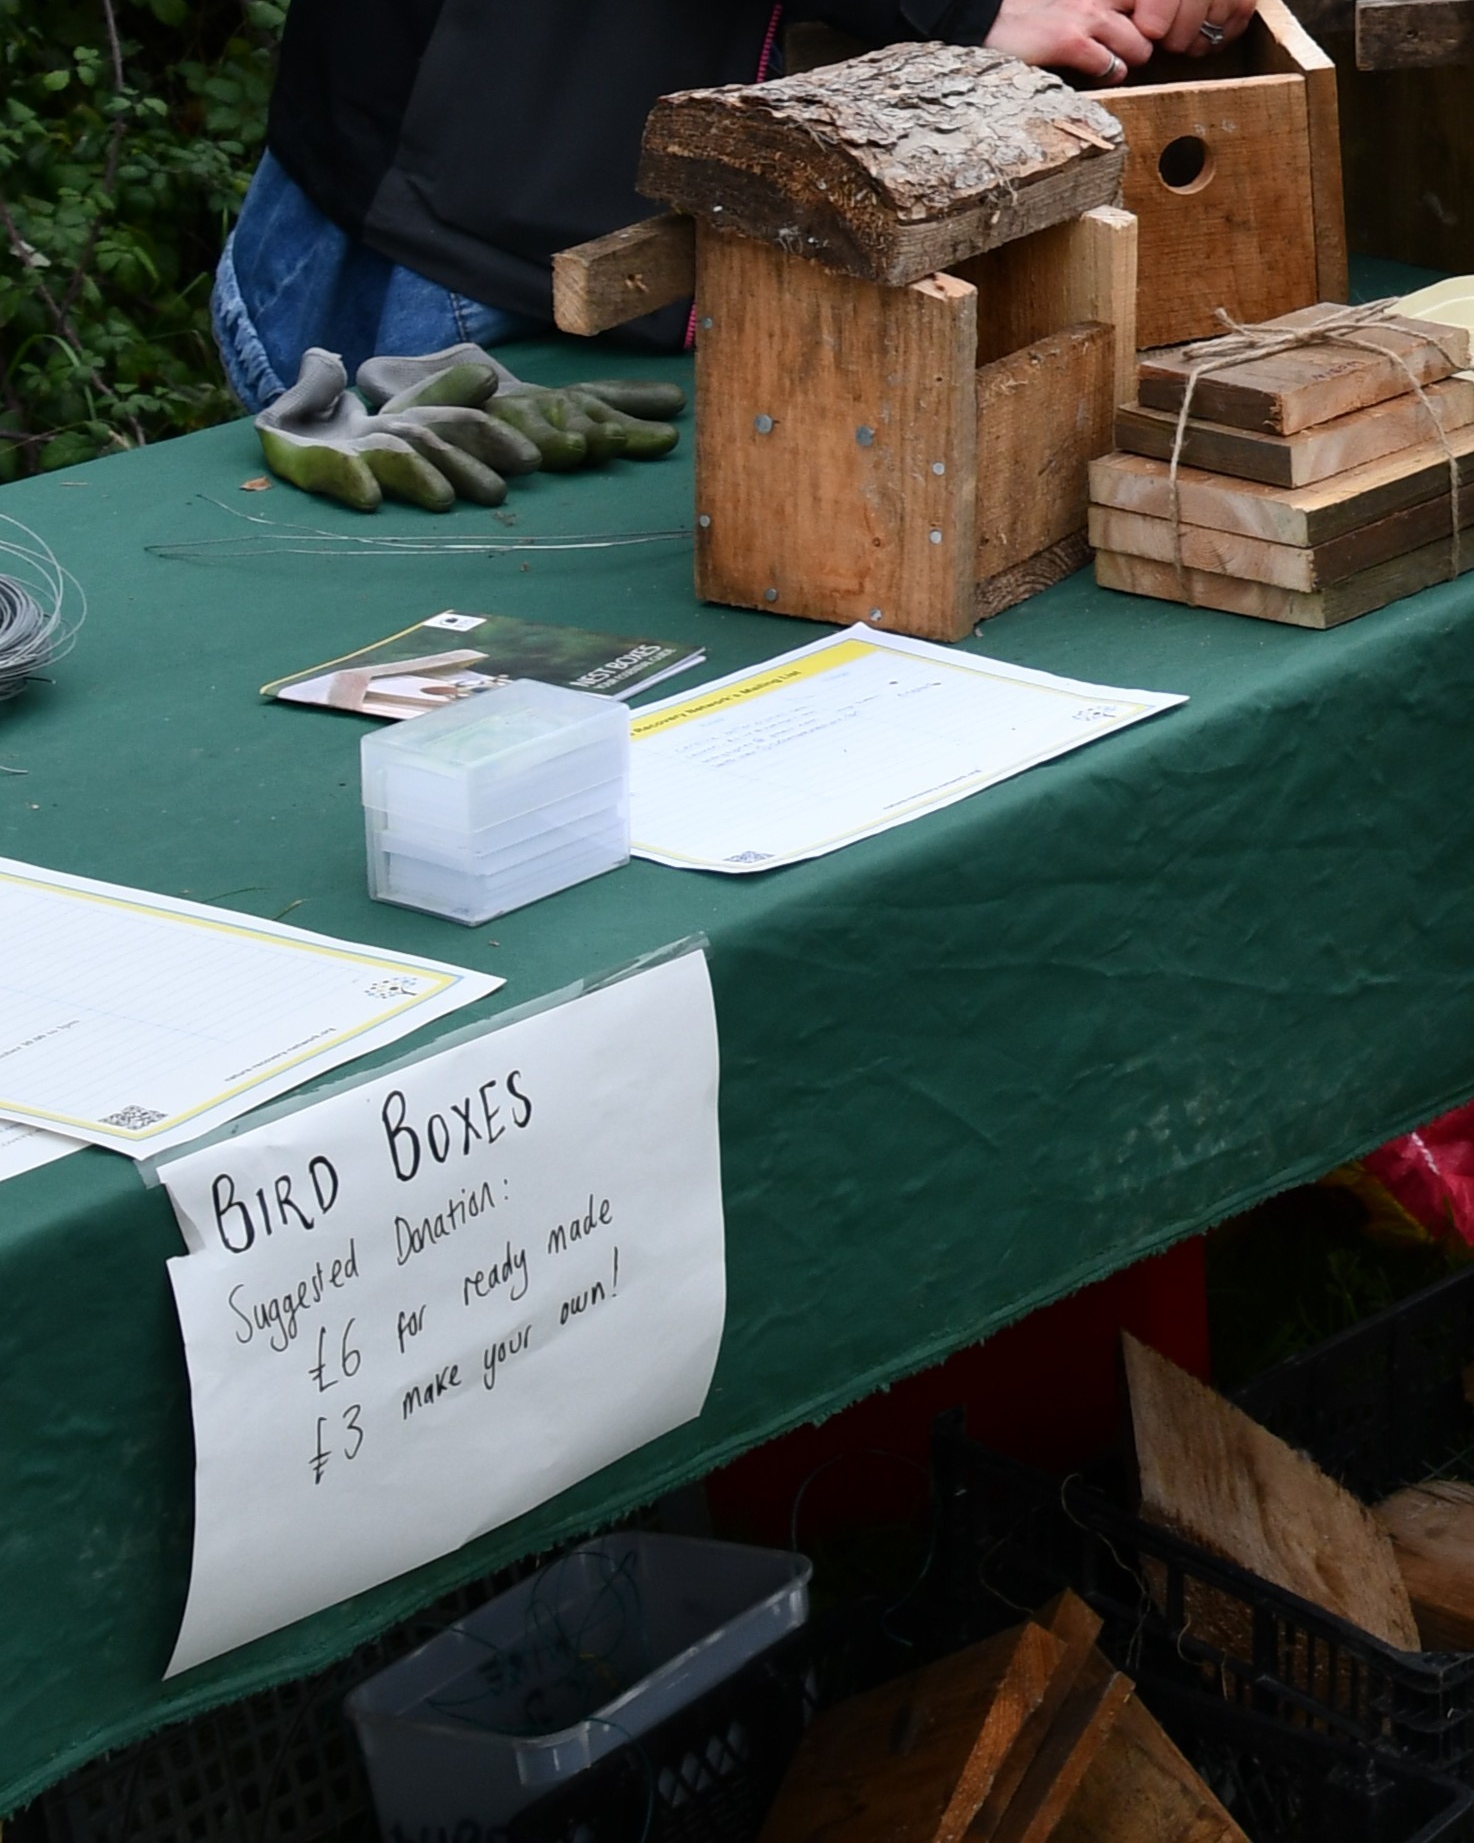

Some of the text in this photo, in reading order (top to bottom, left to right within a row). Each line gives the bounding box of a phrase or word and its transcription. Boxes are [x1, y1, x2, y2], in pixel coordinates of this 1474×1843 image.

[569, 644, 661, 687] NEST BOXES
[633, 712, 686, 734] Recovery
[740, 678, 783, 695] Mailing
[779, 670, 802, 680] List
[210, 1069, 533, 1255] BIRD BOXES
[228, 1178, 510, 1353] Suggested Donation:
[308, 1193, 614, 1393] £6 for ready made
[308, 1246, 620, 1485] £3 make your own!
